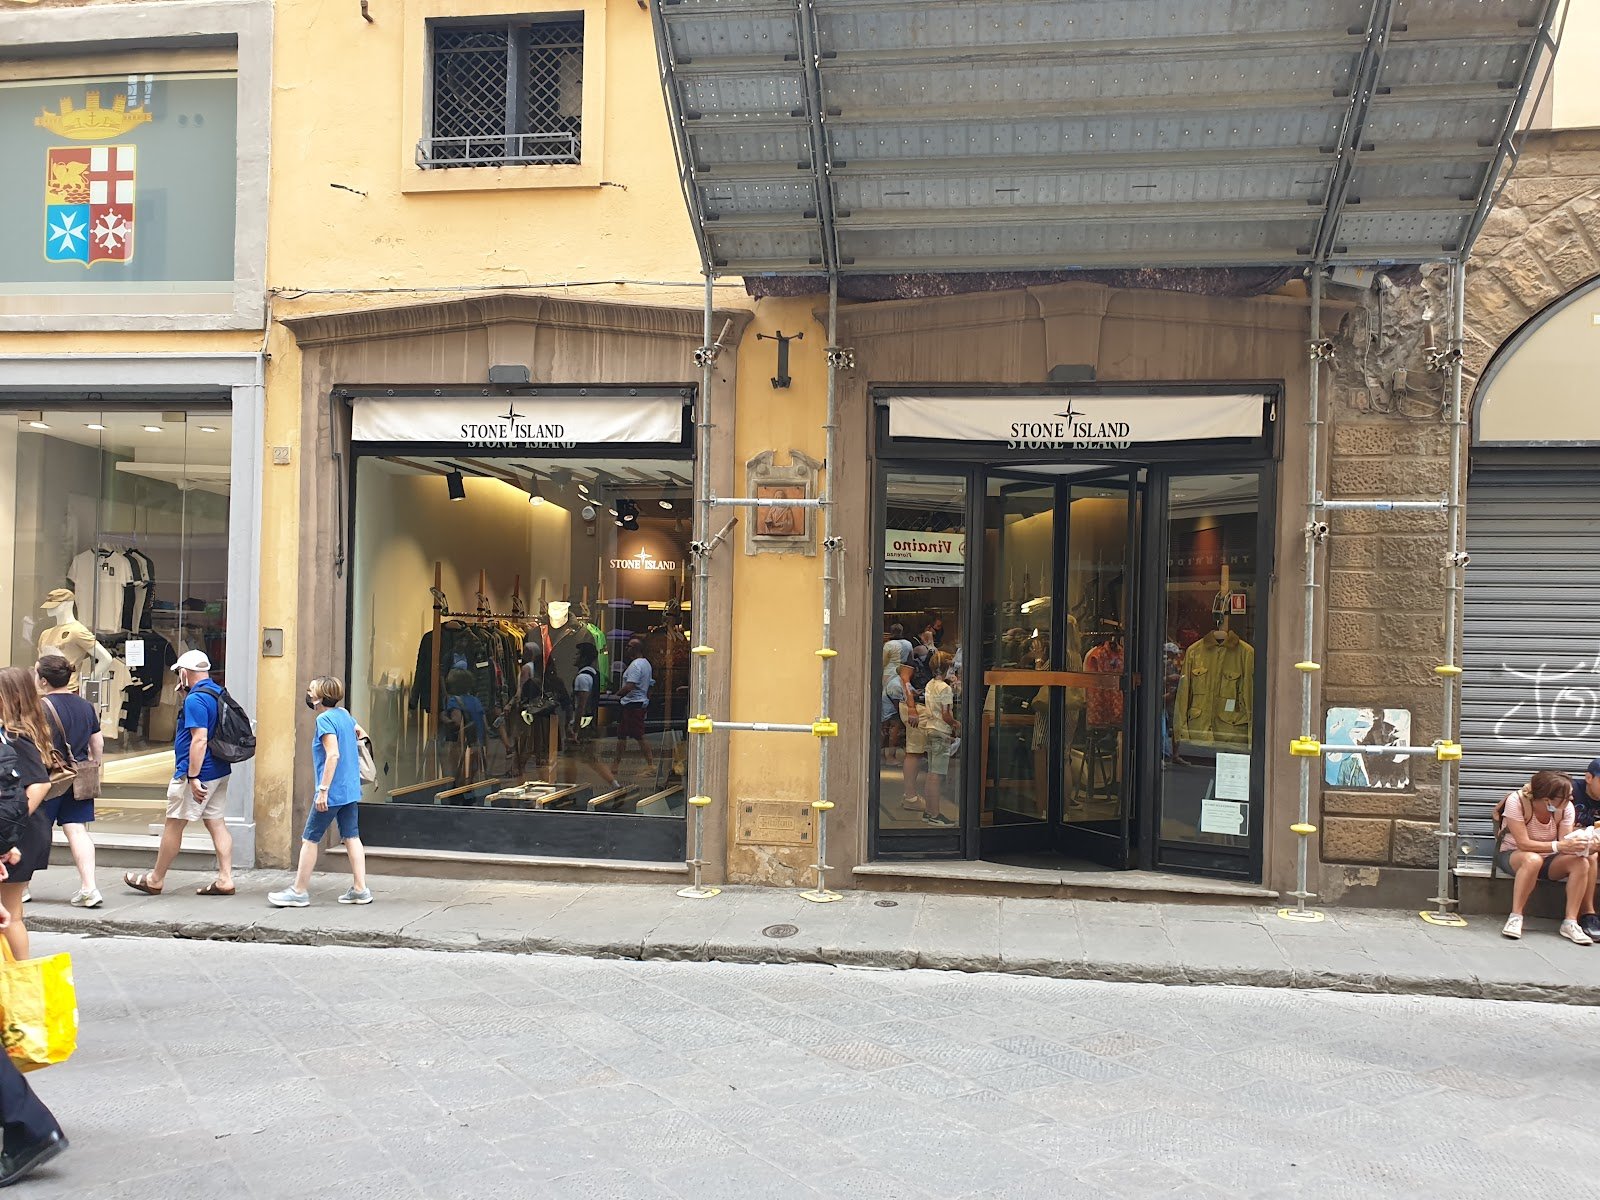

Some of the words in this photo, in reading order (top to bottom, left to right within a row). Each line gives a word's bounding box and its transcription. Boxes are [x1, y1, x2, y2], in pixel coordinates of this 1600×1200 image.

[461, 424, 507, 438] STONE
[514, 424, 564, 438] ISLAND
[1010, 422, 1064, 438] STONE
[1072, 422, 1130, 438] ISLAND
[274, 448, 289, 460] 22
[610, 559, 640, 569] STONE
[644, 560, 676, 570] ISLAND
